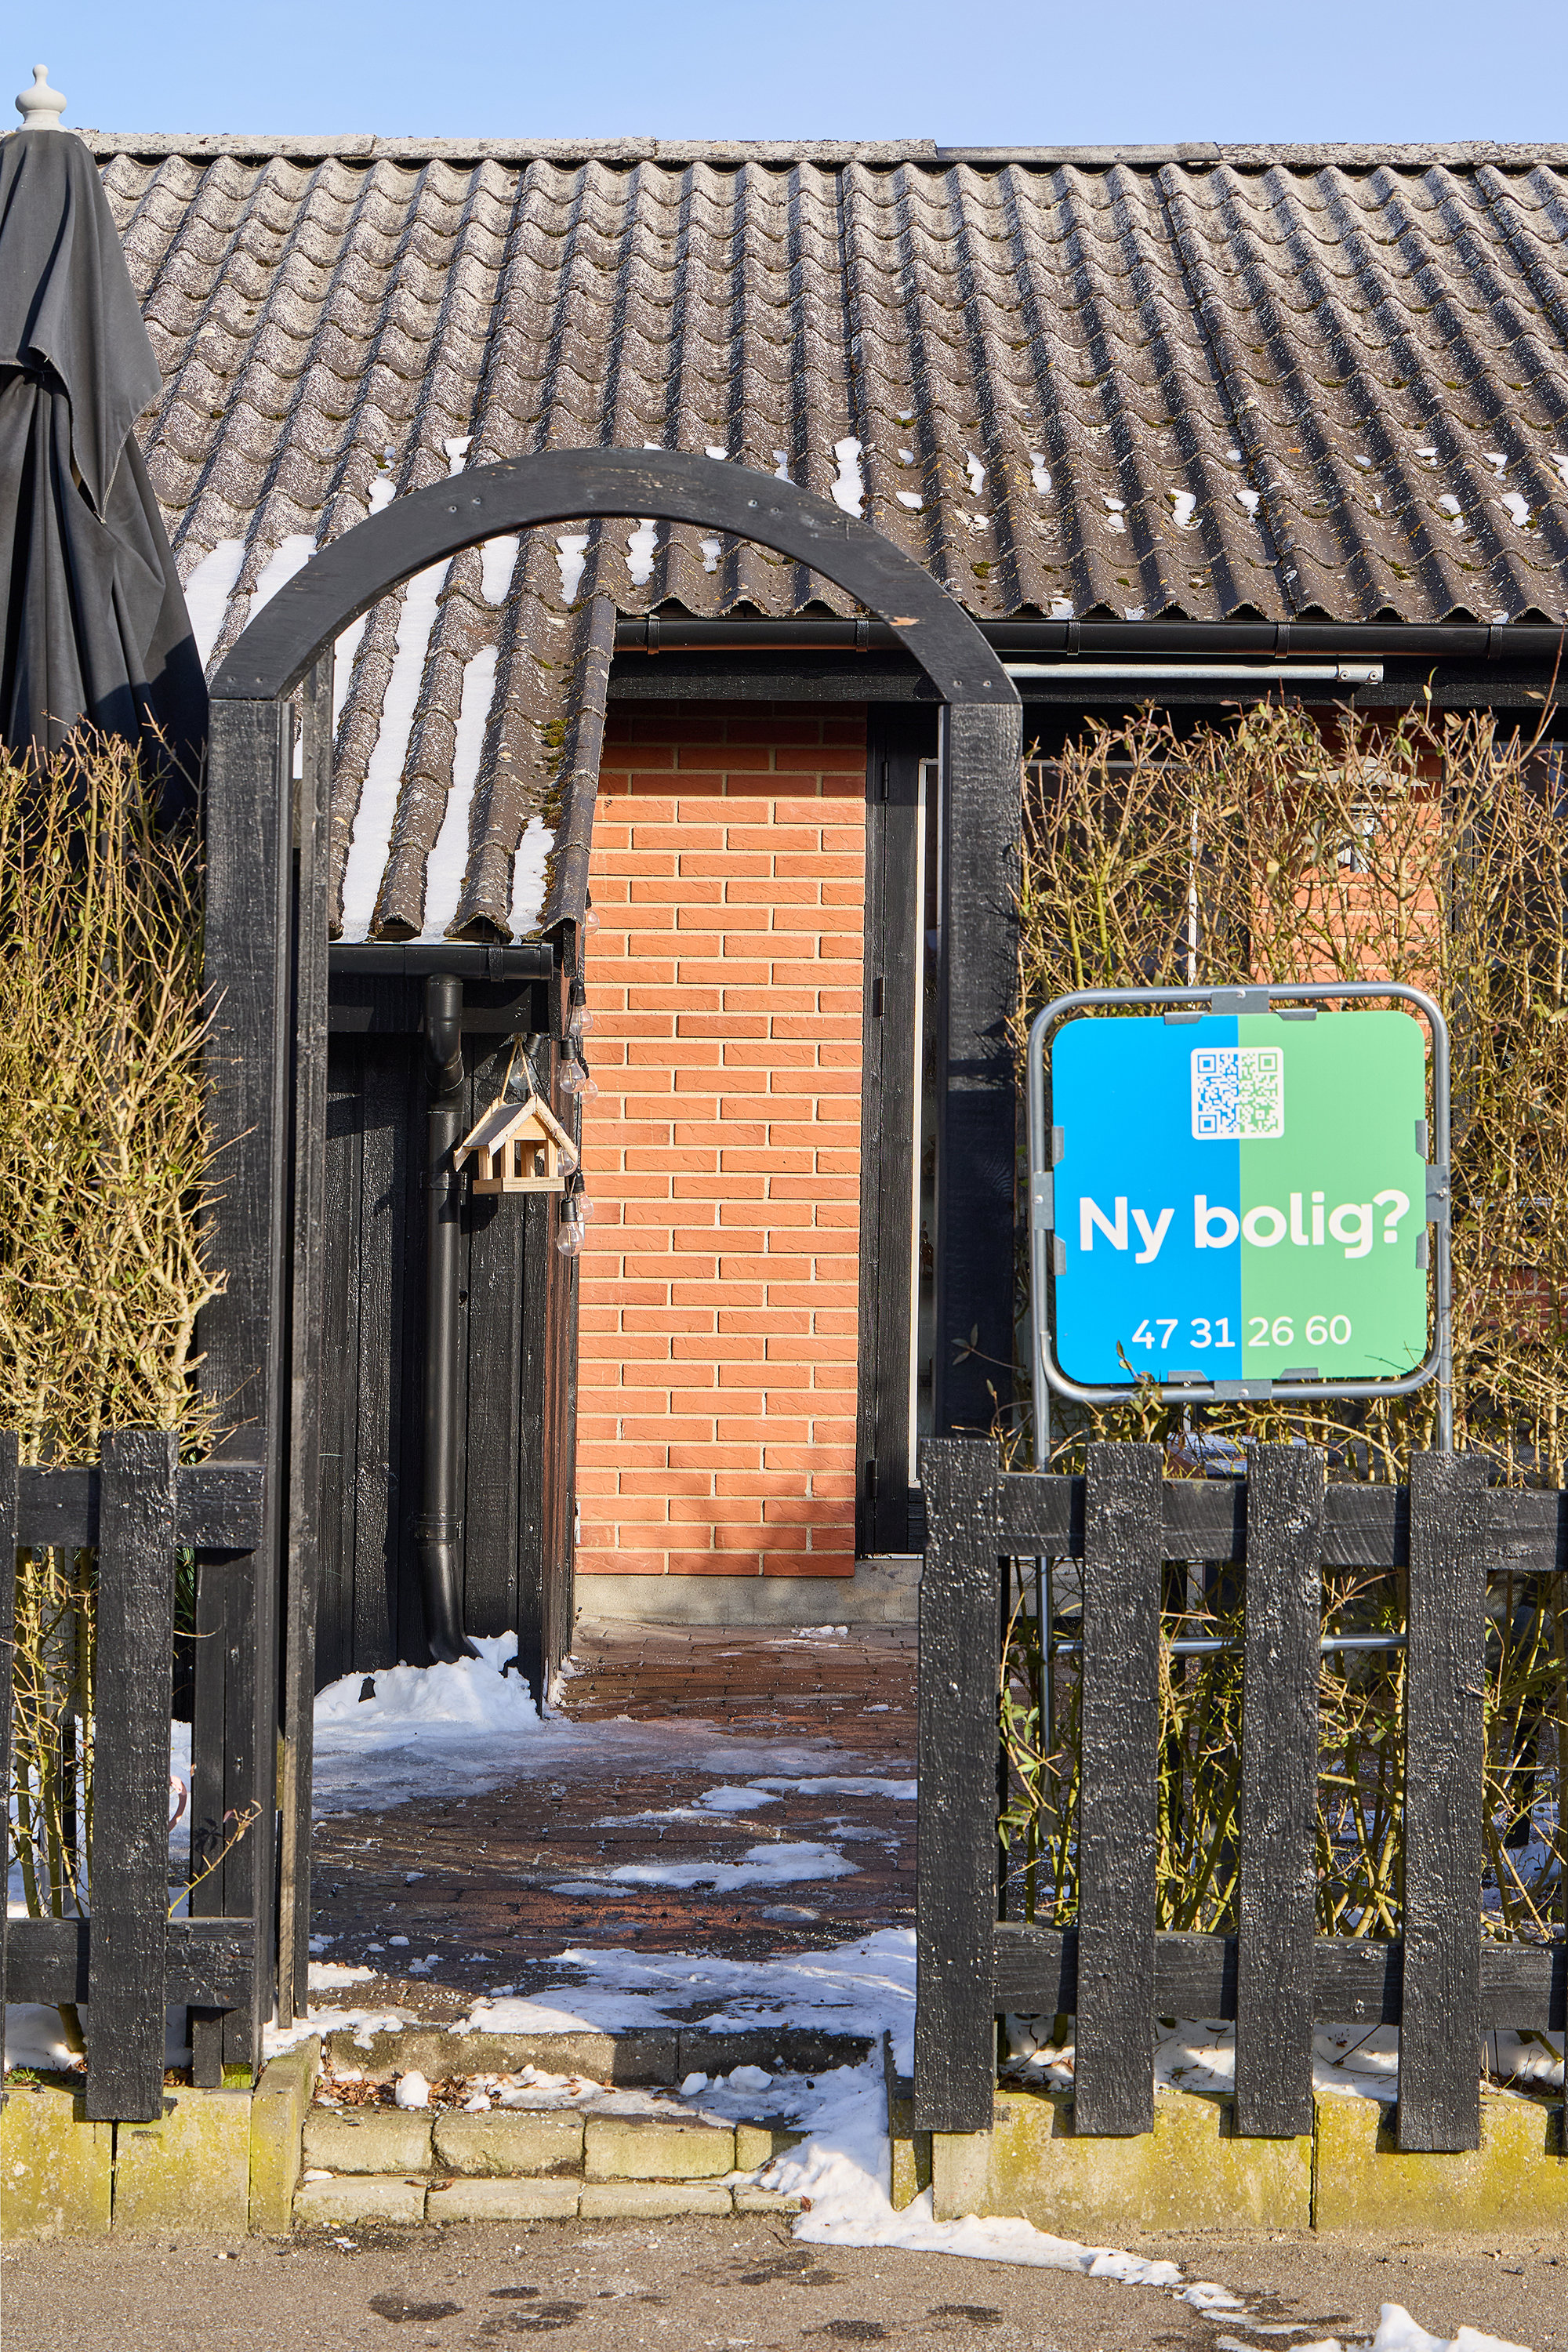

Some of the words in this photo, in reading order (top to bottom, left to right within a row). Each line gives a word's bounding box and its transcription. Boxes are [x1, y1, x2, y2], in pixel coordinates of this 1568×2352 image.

[1080, 1196, 1174, 1264] Ny
[1194, 1189, 1410, 1258] bolig?
[1131, 1319, 1178, 1349] 47
[1190, 1317, 1236, 1348] 31
[1248, 1316, 1294, 1347] 26
[1305, 1315, 1352, 1345] 60
